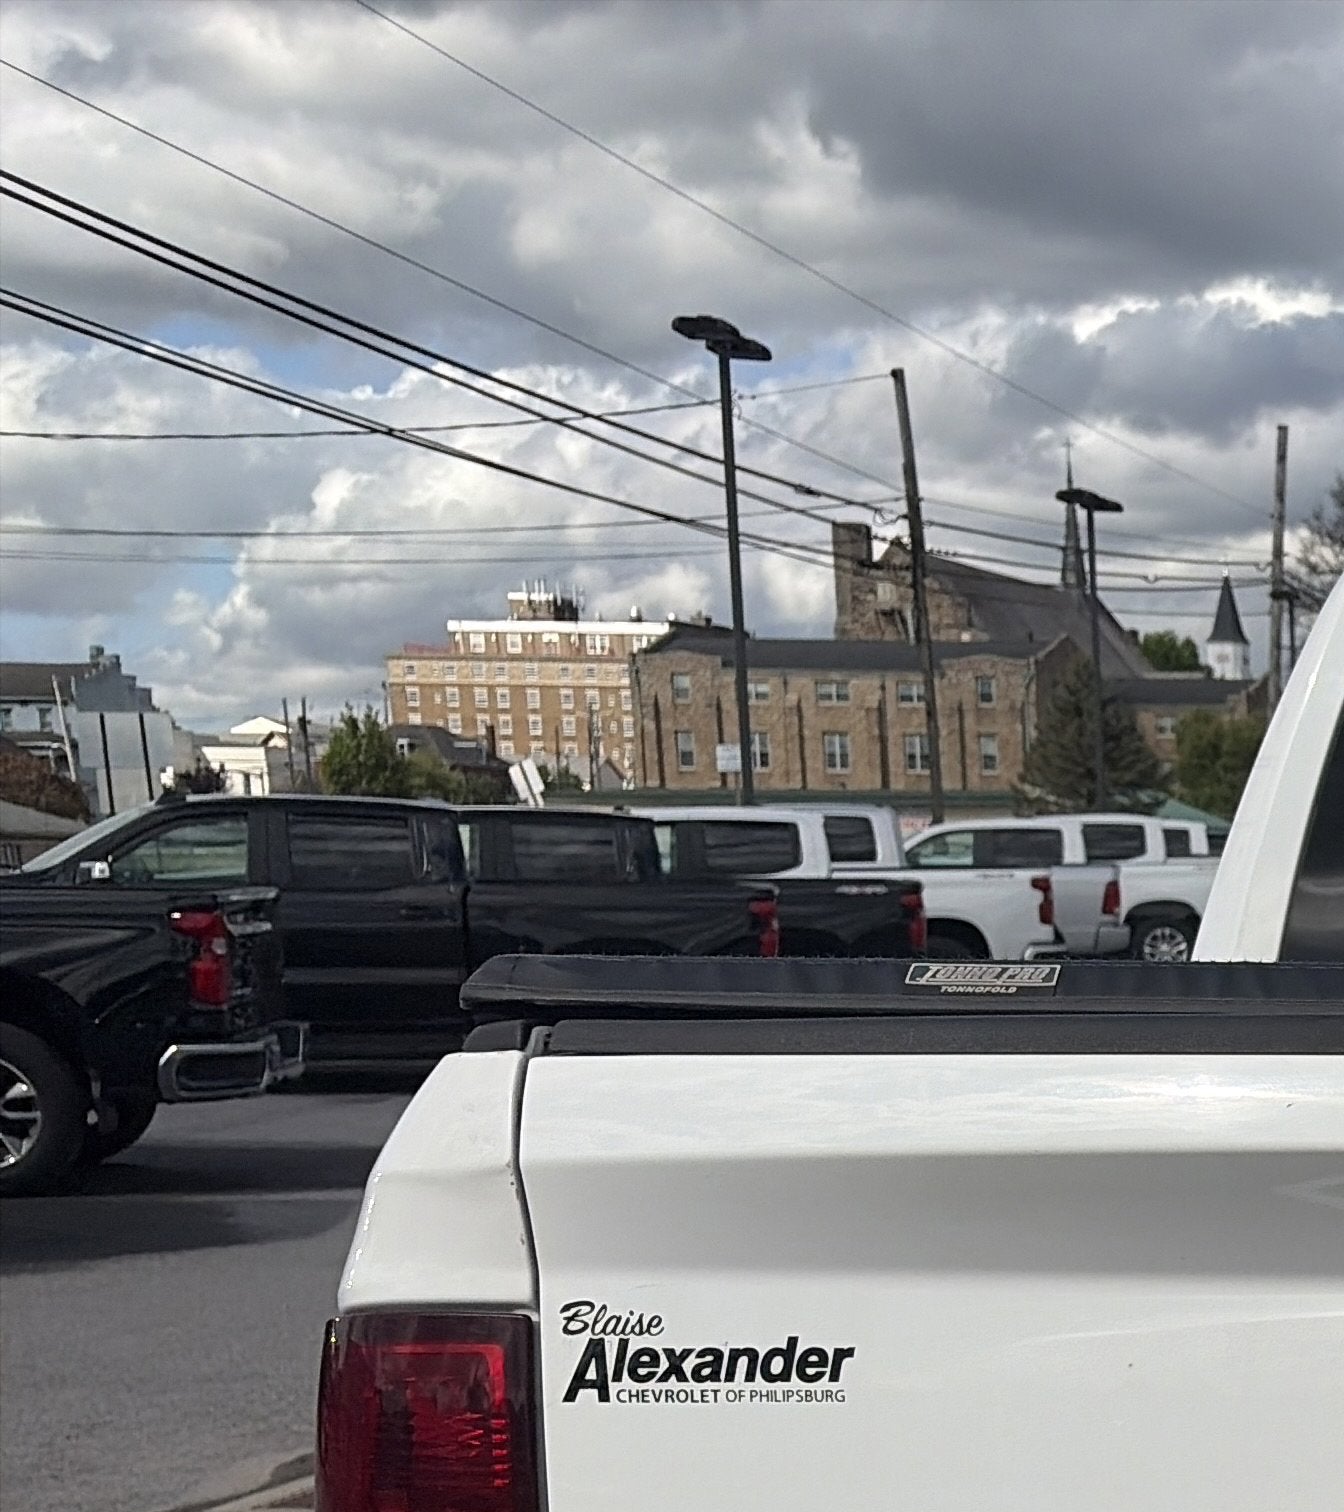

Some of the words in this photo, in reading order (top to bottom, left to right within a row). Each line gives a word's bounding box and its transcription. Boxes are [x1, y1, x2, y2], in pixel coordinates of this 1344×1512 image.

[920, 966, 1001, 982] TONNO
[998, 967, 1050, 983] PRO
[560, 1301, 664, 1336] Blaise
[562, 1336, 855, 1402] Alexander
[616, 1389, 719, 1403] CHEVROLET
[725, 1389, 748, 1403] OF
[750, 1389, 846, 1403] PHILIPSBURG
